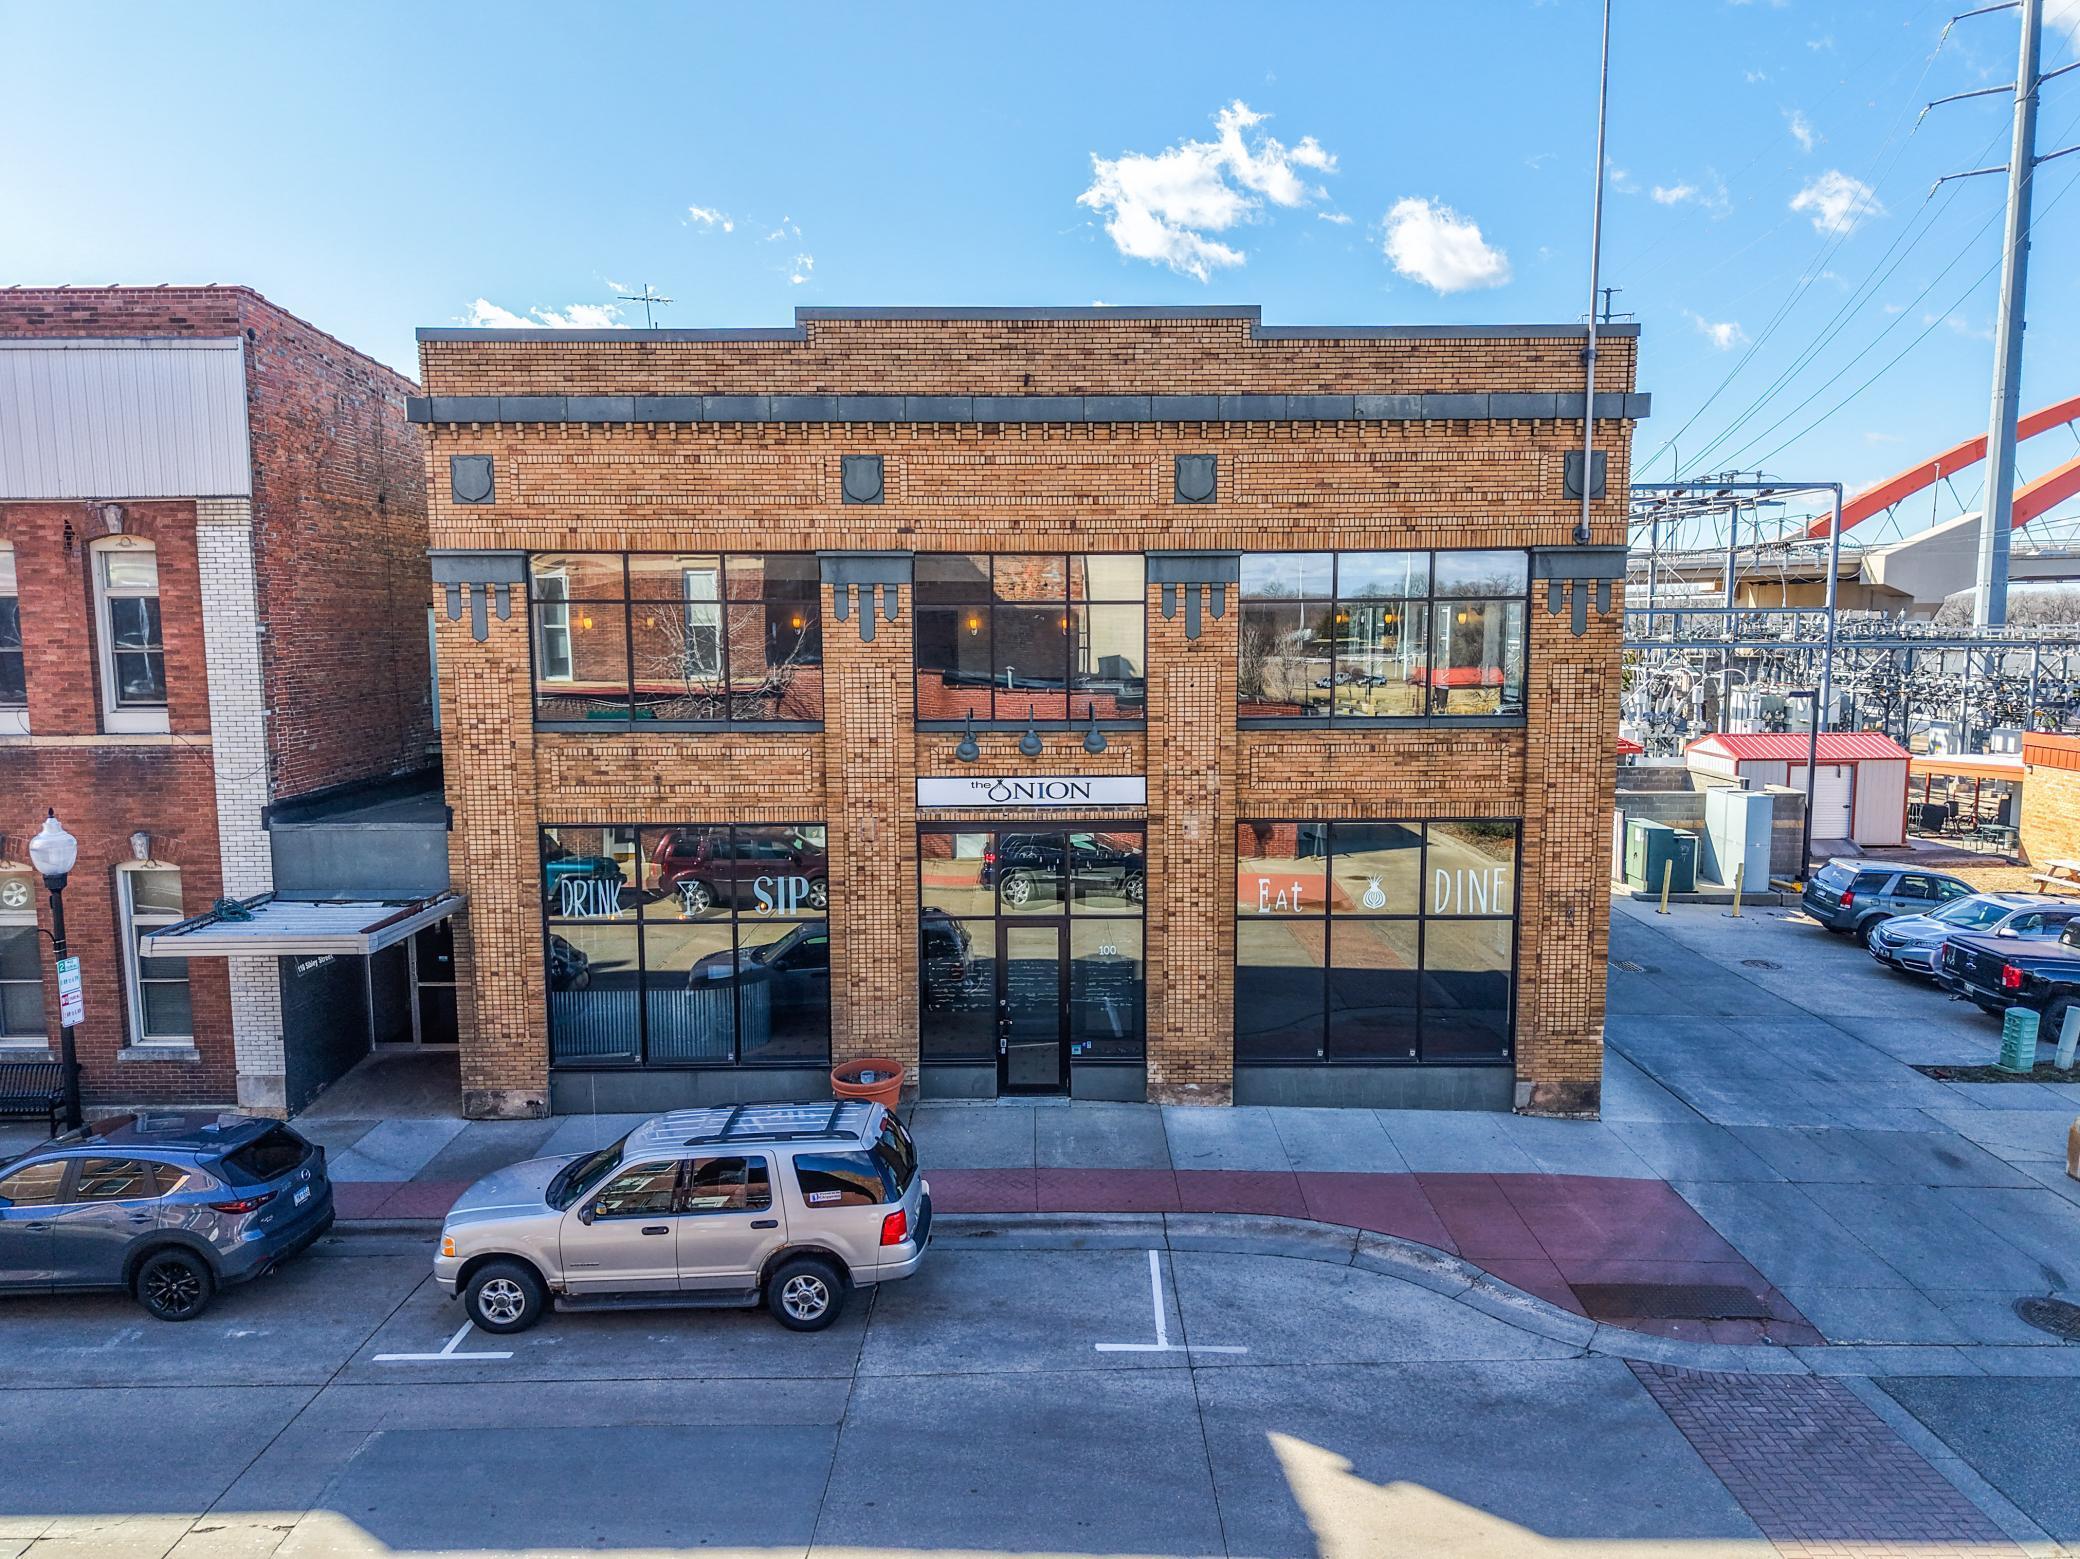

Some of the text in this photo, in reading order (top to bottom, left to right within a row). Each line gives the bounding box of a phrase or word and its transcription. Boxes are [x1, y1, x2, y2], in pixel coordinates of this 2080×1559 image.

[971, 779, 1092, 802] the ONION
[561, 878, 624, 918] DRINK
[752, 875, 810, 915] SIP
[1435, 867, 1507, 914] DINE
[1098, 945, 1116, 956] 100
[59, 963, 65, 972] 2
